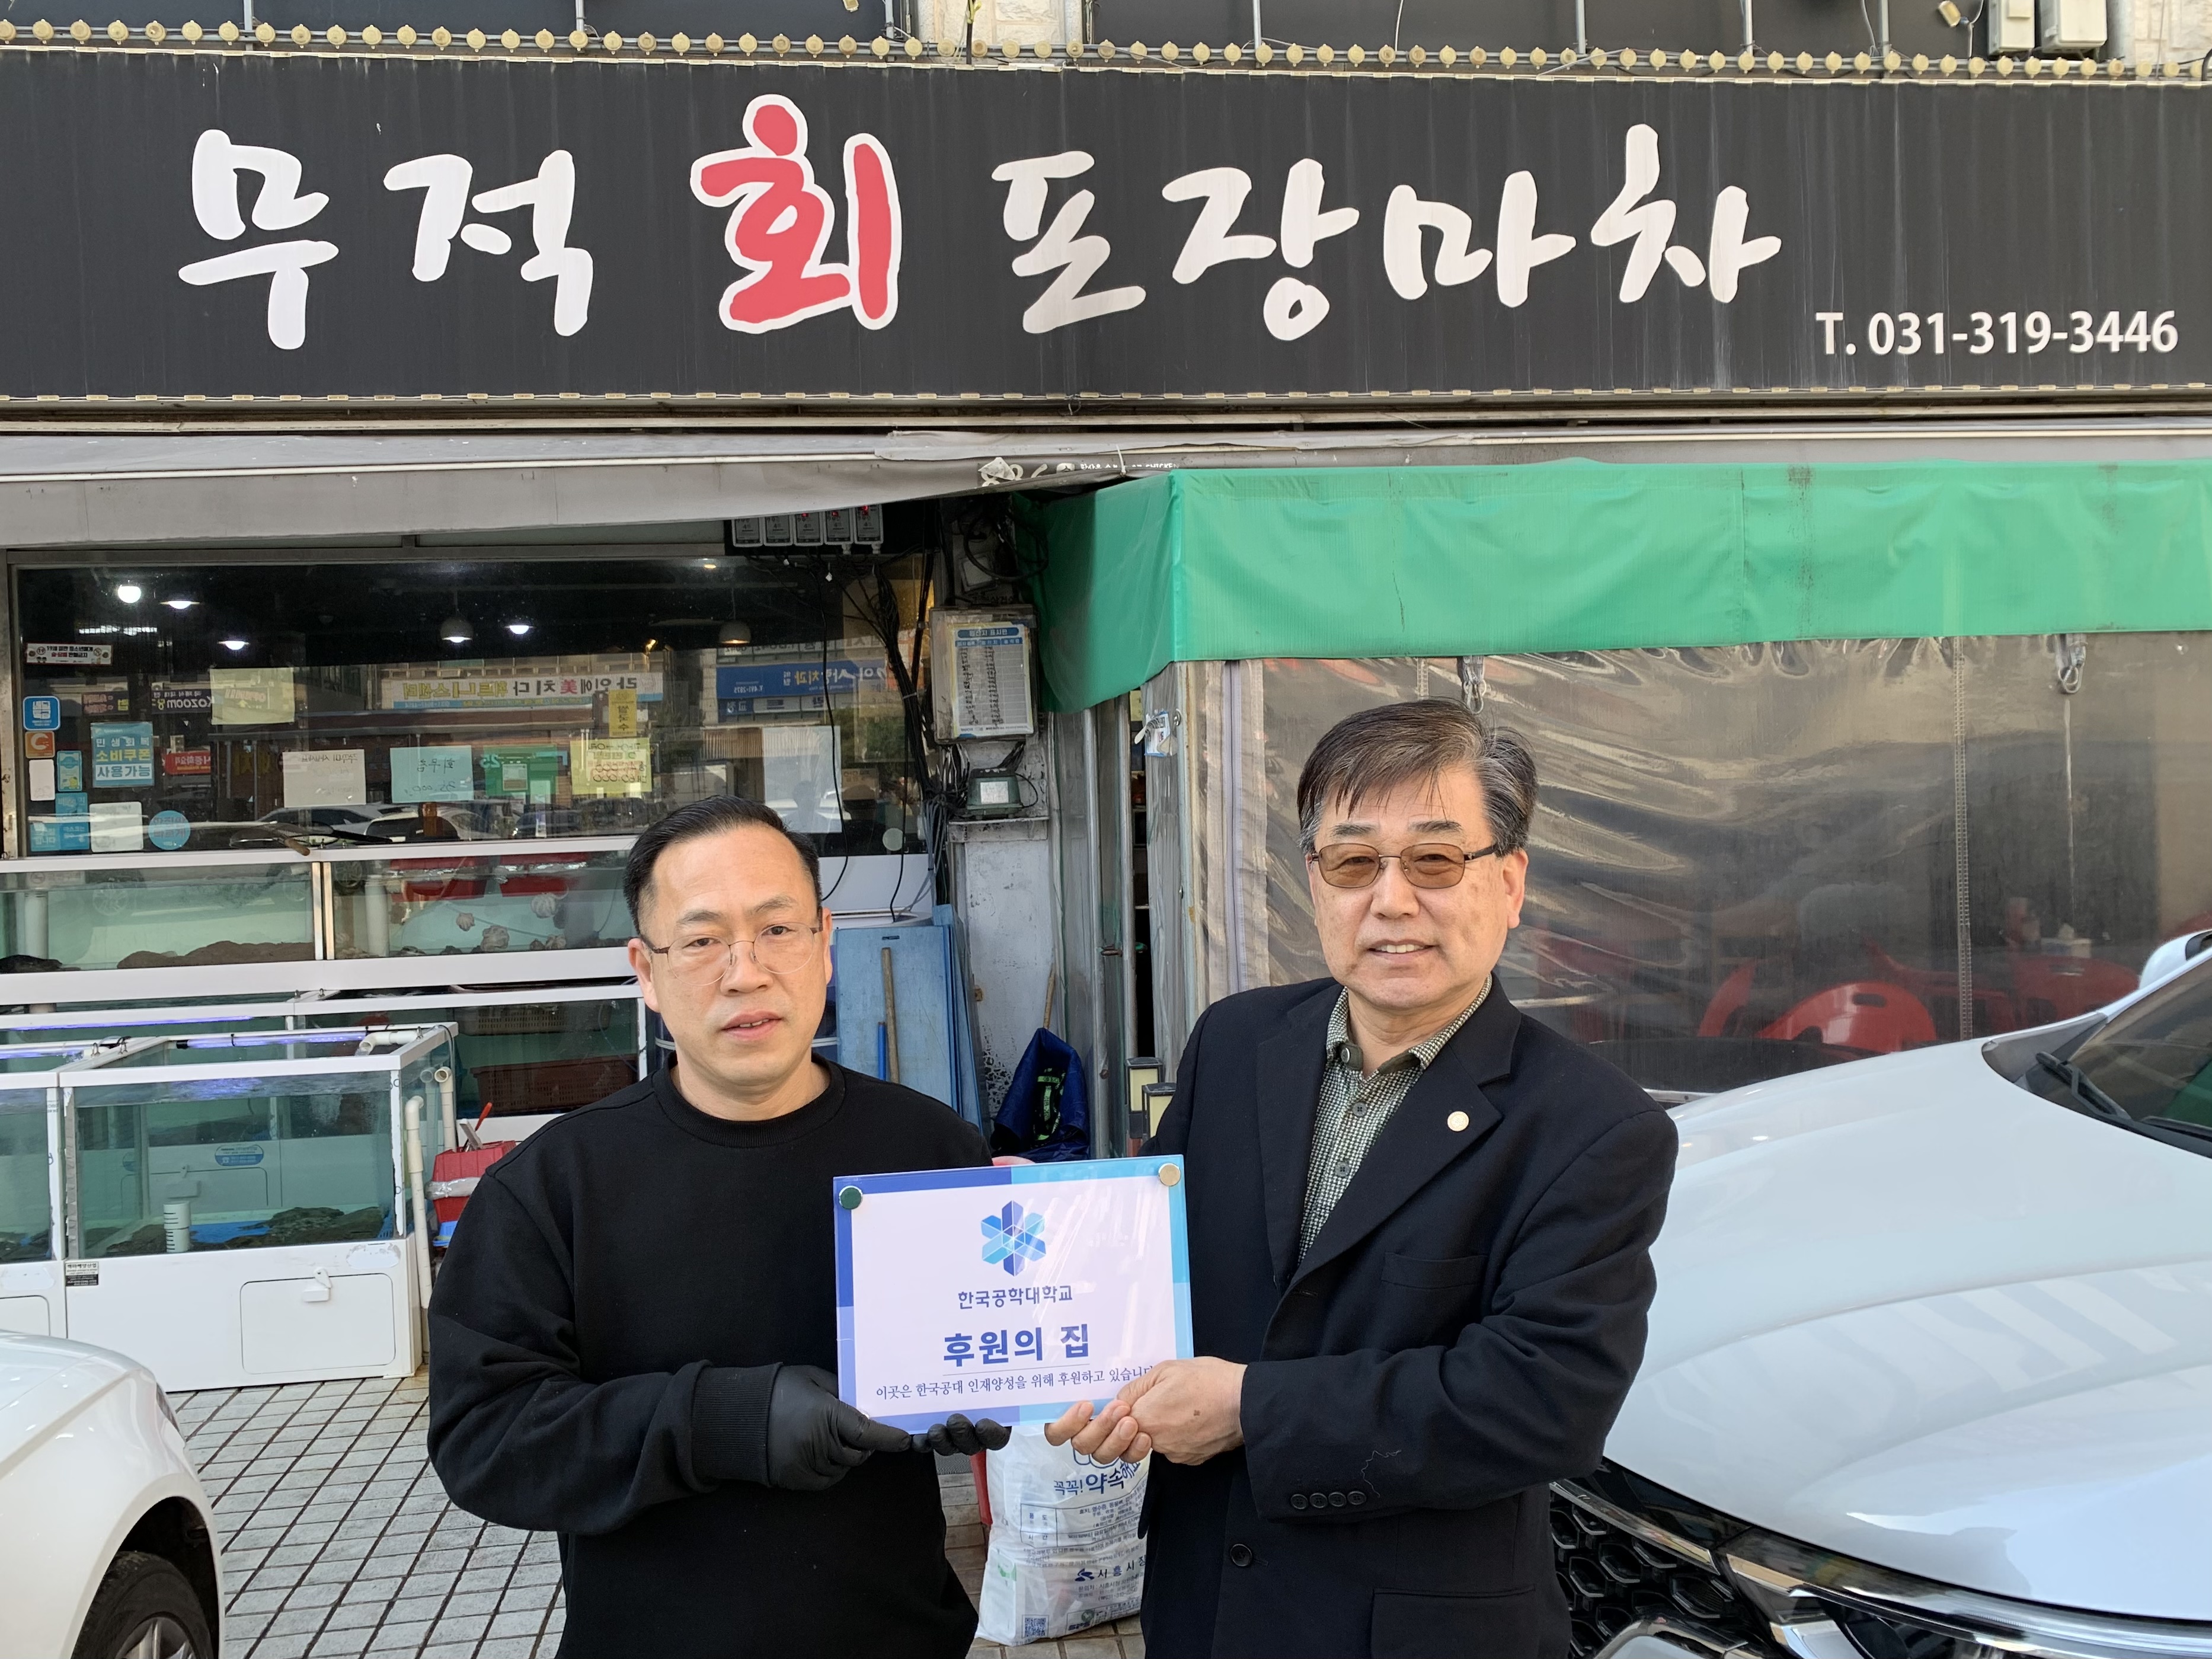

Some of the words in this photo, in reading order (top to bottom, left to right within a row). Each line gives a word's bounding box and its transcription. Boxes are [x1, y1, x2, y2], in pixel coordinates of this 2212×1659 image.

[178, 130, 593, 349] 무적
[690, 94, 902, 334] 회
[992, 124, 1781, 340] 포장마차
[1816, 313, 1856, 354] T.
[1869, 311, 2178, 356] 031-319-3446
[95, 749, 151, 762] 소비쿠폰
[97, 765, 151, 778] 사용가능
[958, 1285, 1073, 1310] 한국공학대학교
[944, 1326, 1043, 1367] 후원의
[1060, 1324, 1089, 1358] 집
[877, 1385, 912, 1401] 이곳은
[916, 1380, 963, 1397] 한국공대
[968, 1374, 1027, 1393] 인재양성을
[1031, 1373, 1054, 1388] 위해
[1057, 1369, 1105, 1386] 후원하고
[1054, 1479, 1083, 1495] 꼭꼭!
